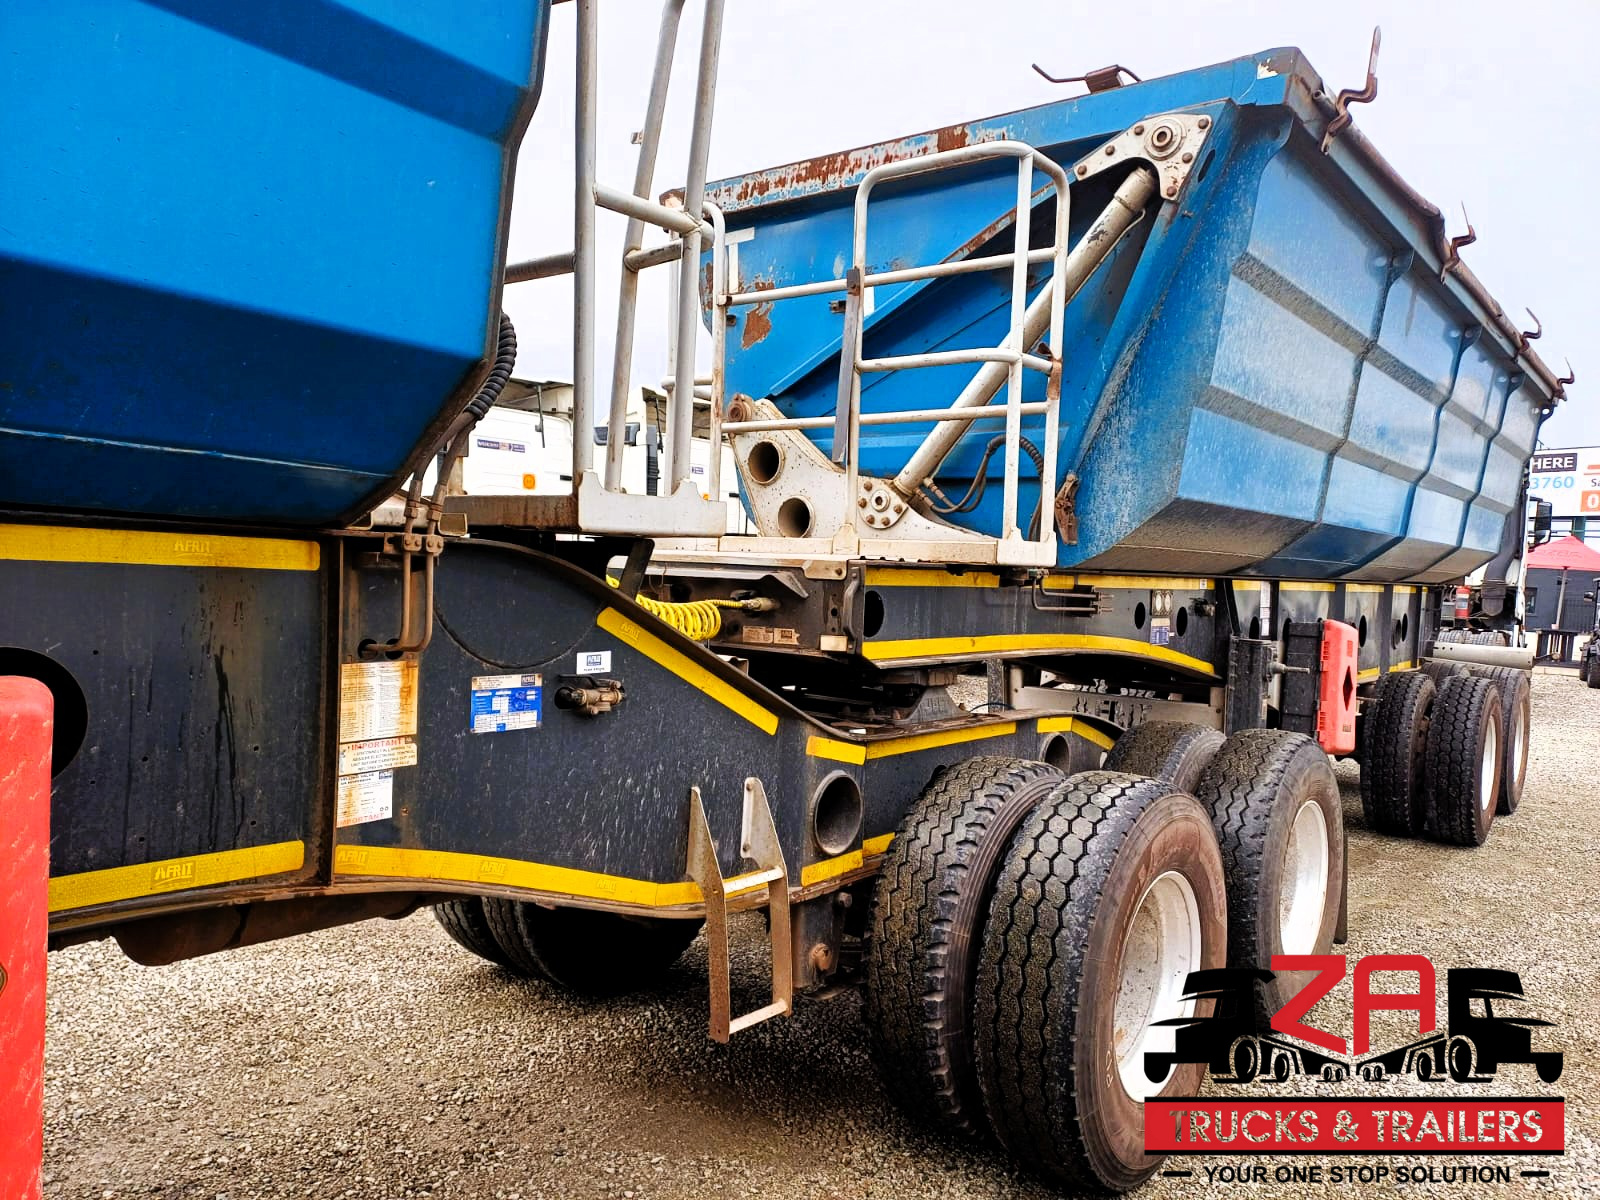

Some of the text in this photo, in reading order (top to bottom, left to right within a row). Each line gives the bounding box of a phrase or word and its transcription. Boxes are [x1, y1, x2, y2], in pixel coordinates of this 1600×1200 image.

[1530, 476, 1574, 489] 3760
[352, 739, 401, 750] IMPORTANT
[337, 850, 367, 863] AFRIT
[154, 862, 193, 880] AFRIT
[480, 861, 506, 874] AFRIT
